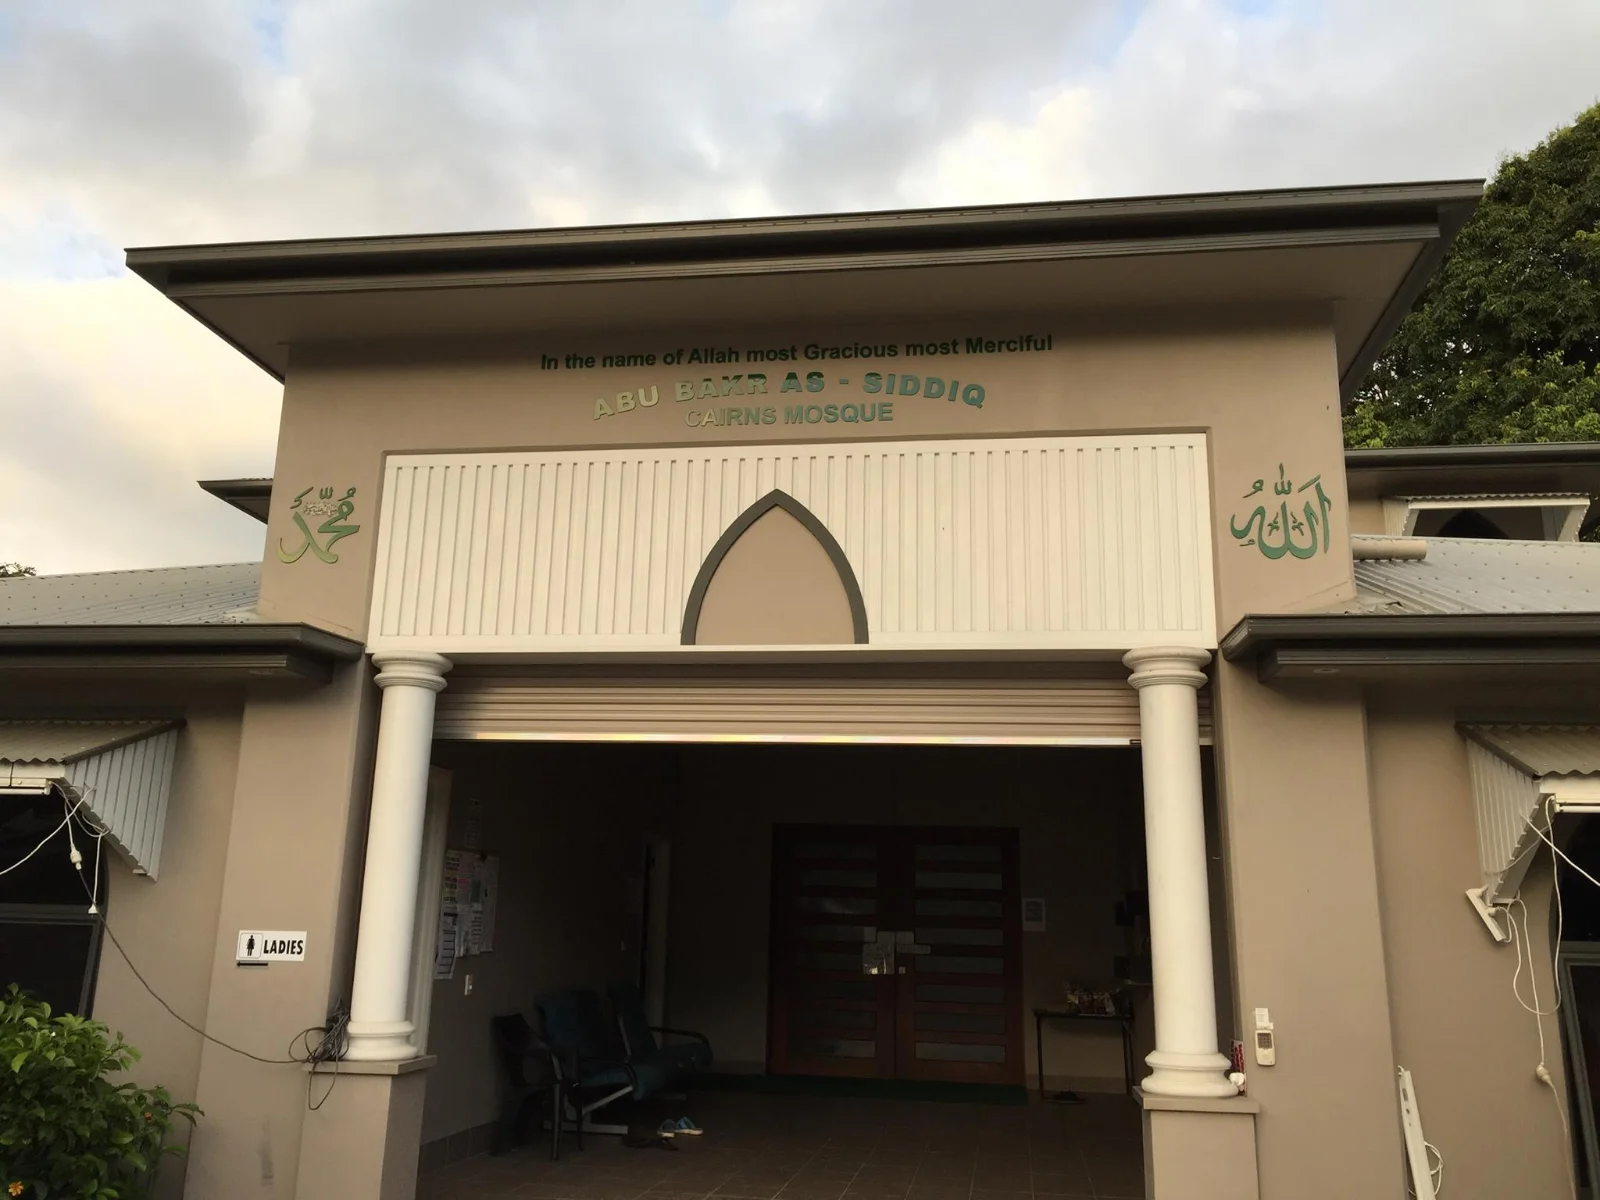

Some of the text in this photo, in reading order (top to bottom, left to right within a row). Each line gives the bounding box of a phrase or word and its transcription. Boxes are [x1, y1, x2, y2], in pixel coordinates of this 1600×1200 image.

[541, 335, 1053, 370] In the name of Allah most Gracious most Merciful
[593, 385, 659, 420] ABU
[675, 373, 768, 402] BAKR
[780, 371, 825, 393] AS
[863, 372, 986, 409] SIDDIQ
[685, 402, 894, 427] CAIRNS MOSQUE
[263, 939, 304, 955] LADIES
